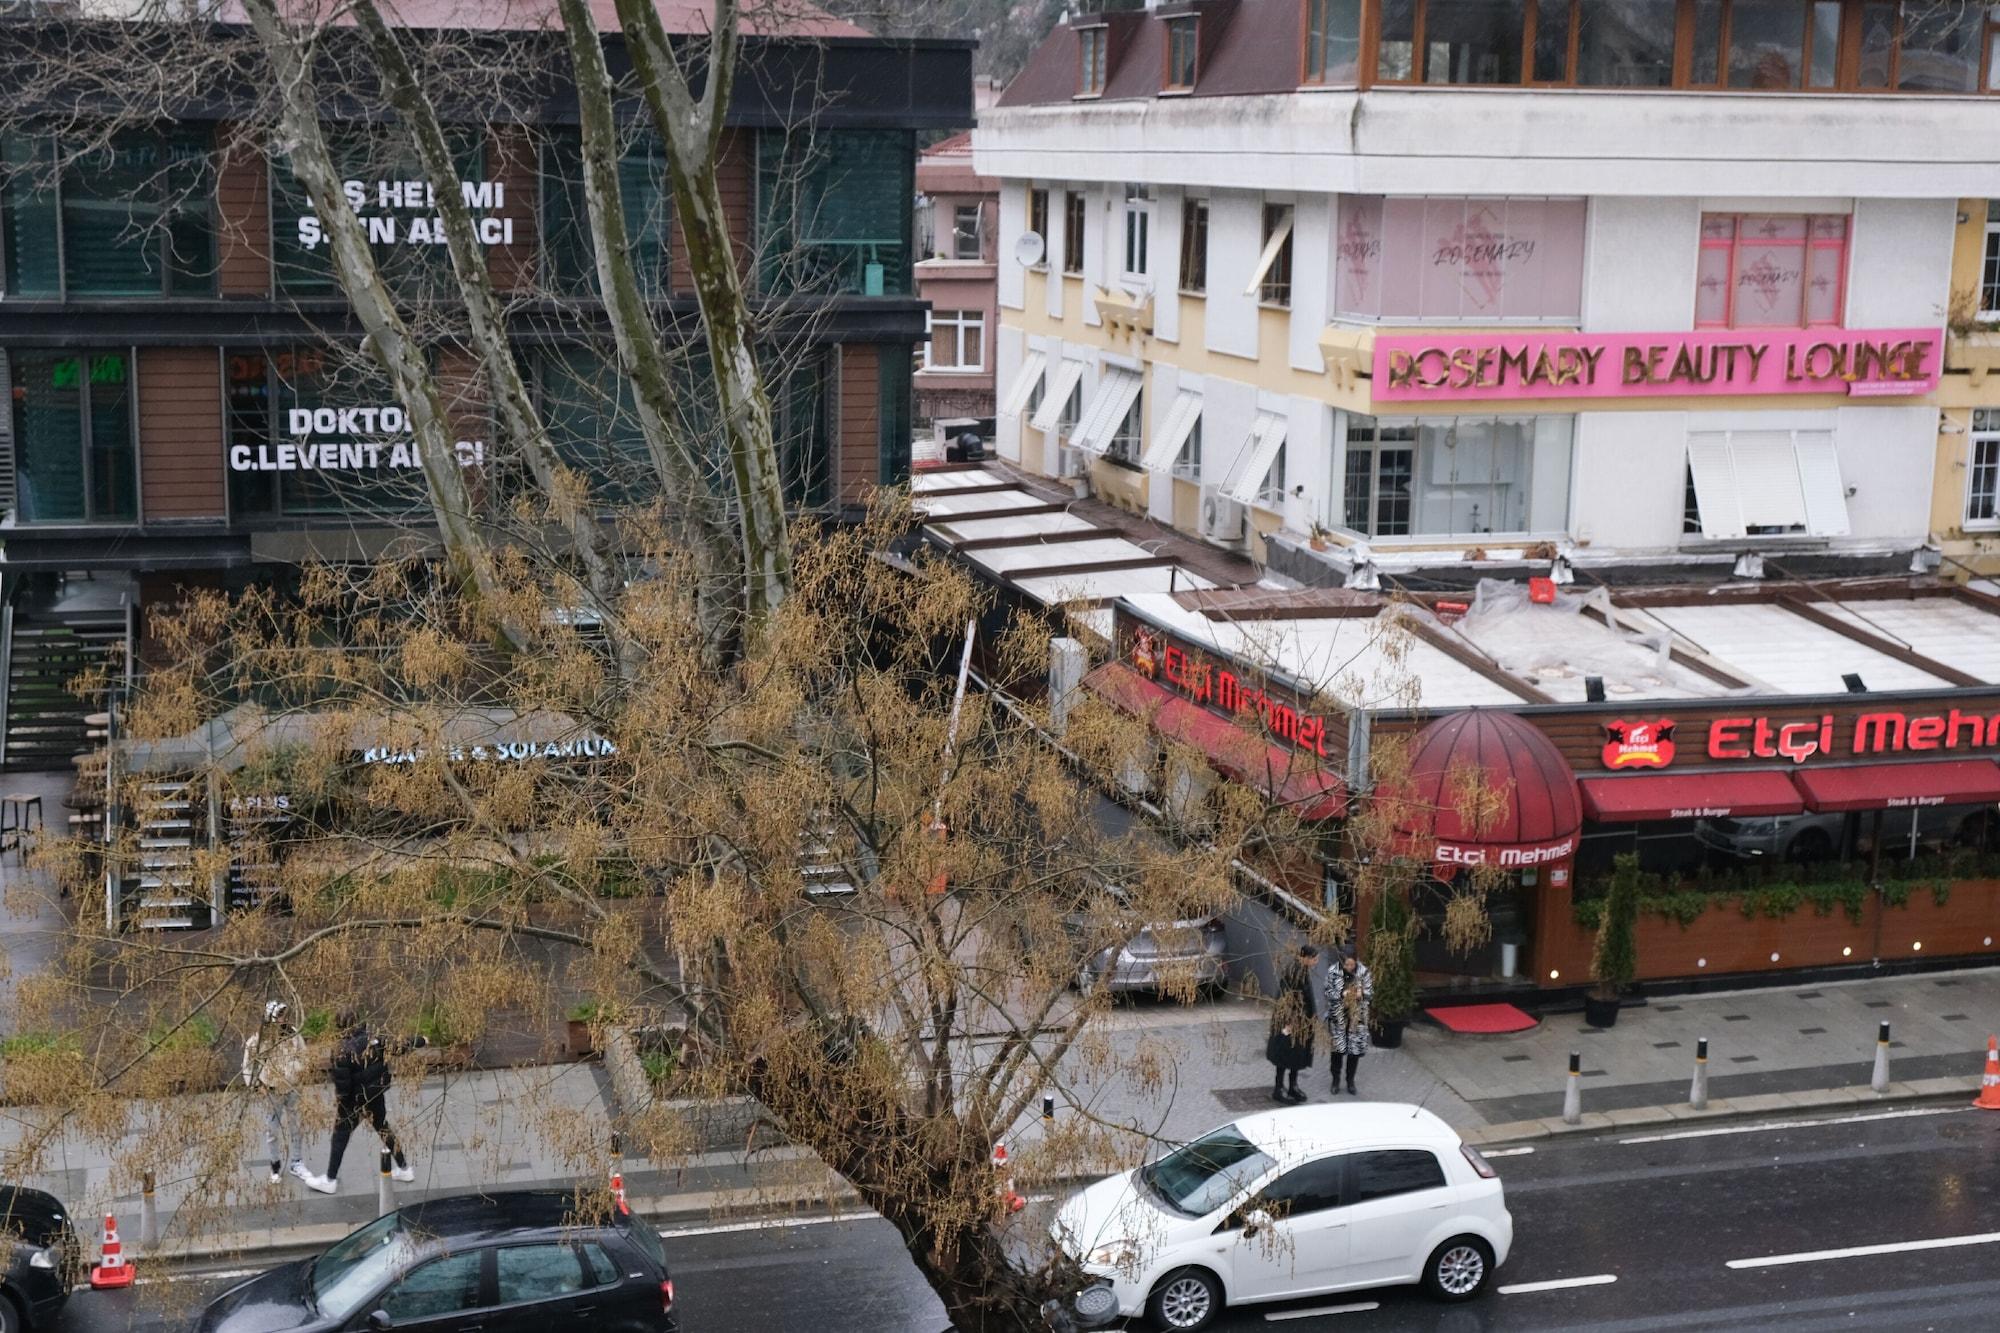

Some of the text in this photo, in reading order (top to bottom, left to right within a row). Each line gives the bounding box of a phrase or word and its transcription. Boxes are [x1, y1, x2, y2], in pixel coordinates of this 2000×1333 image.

[1389, 340, 1934, 389] ROSEMARY BEAUTY LOUNGE
[230, 443, 380, 471] C.LEVENT
[1708, 709, 2000, 763] Etçi Meh
[1671, 808, 1694, 818] Steak
[1703, 807, 1730, 818] Burger
[1500, 839, 1573, 865] Mehmet
